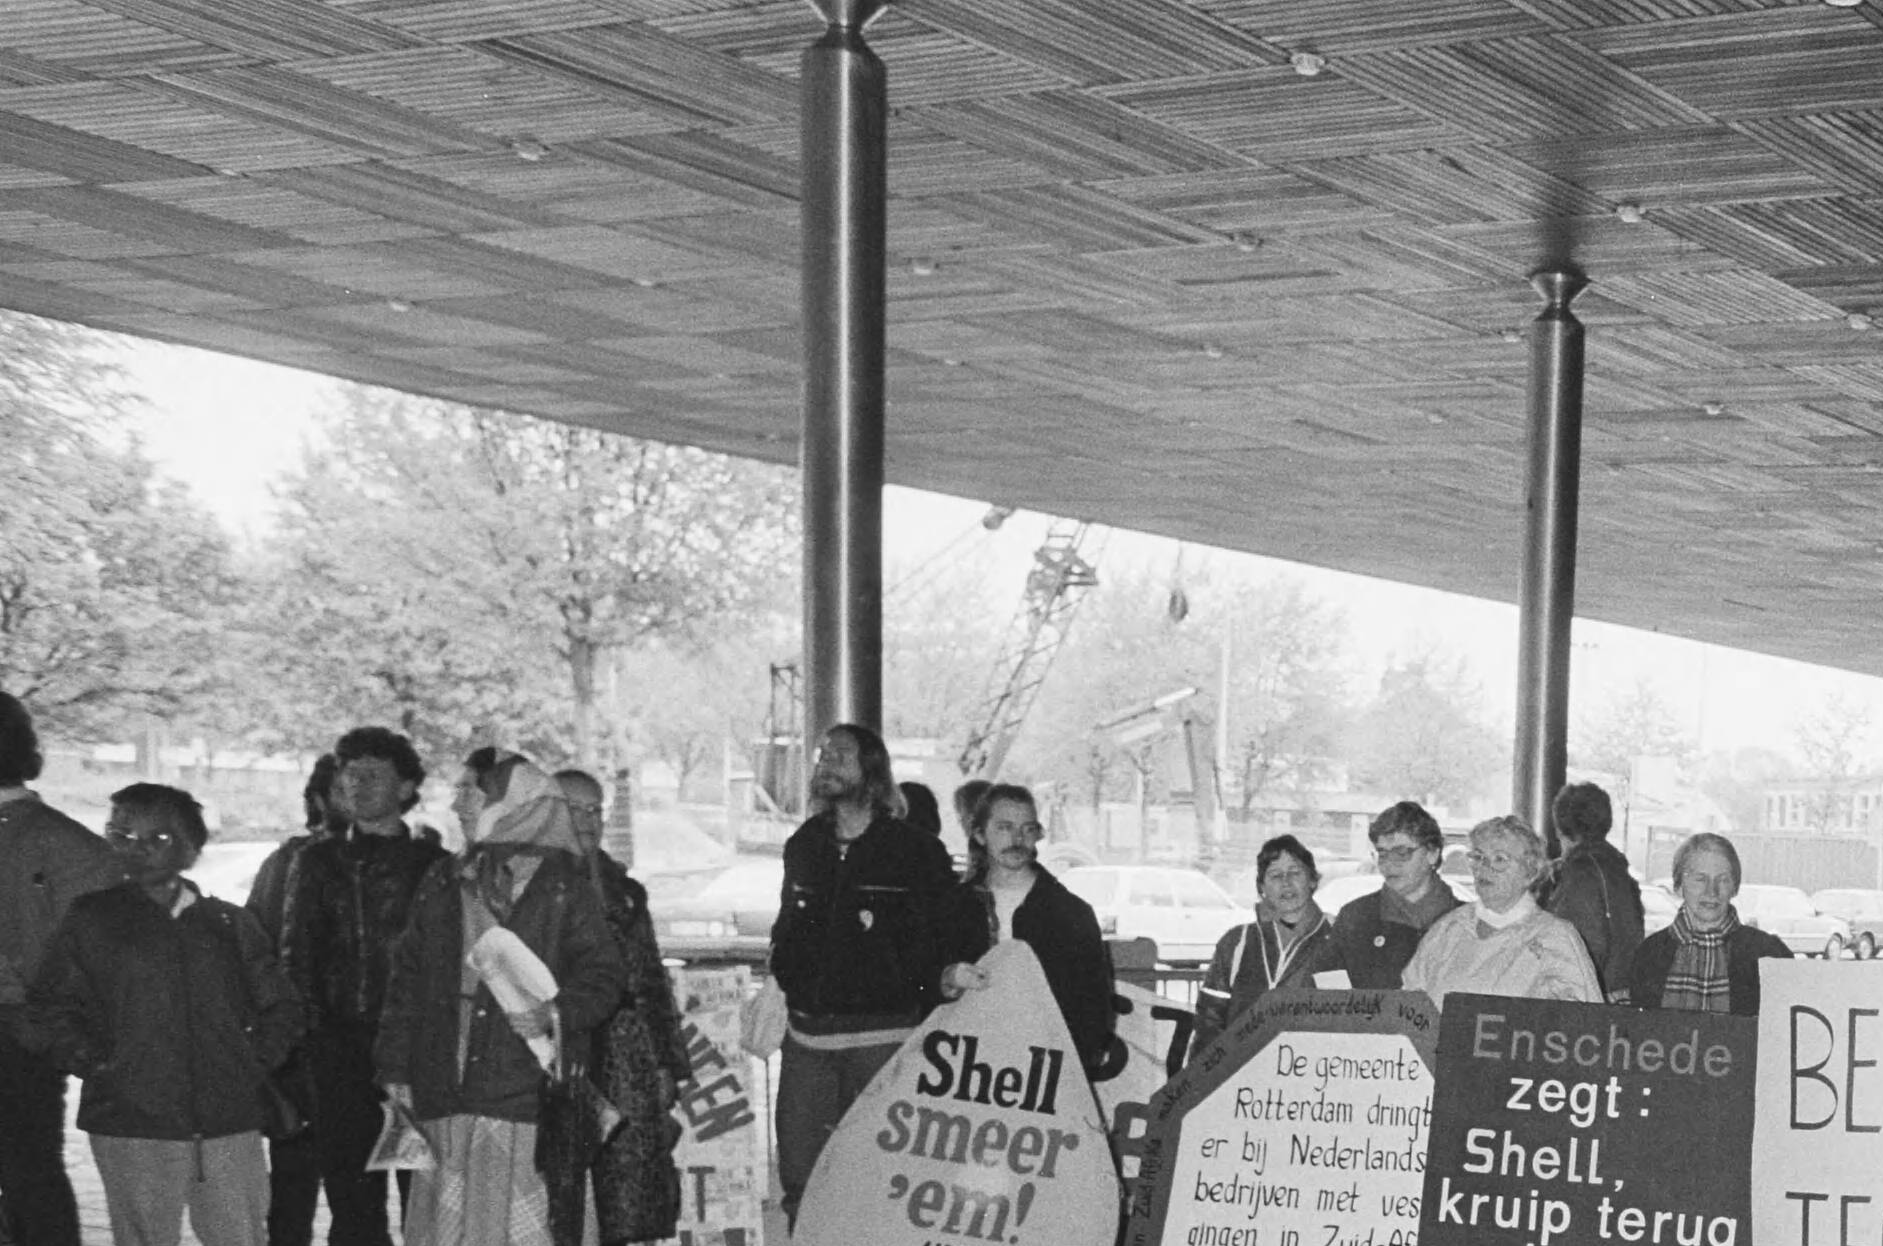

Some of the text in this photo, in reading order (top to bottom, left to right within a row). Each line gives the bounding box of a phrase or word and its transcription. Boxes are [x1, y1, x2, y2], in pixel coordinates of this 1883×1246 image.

[916, 1029, 1065, 1115] Shell
[1277, 1044, 1419, 1091] De gemeente
[1473, 1012, 1732, 1078] Enschede
[876, 1099, 1080, 1178] smeer
[1234, 1087, 1432, 1142] Rotterdam dringt
[1200, 1131, 1428, 1176] er bij Nederlands
[1463, 1127, 1624, 1192] Shell,
[1194, 1170, 1422, 1219] bedrijven met ves
[1438, 1177, 1572, 1246] kruip
